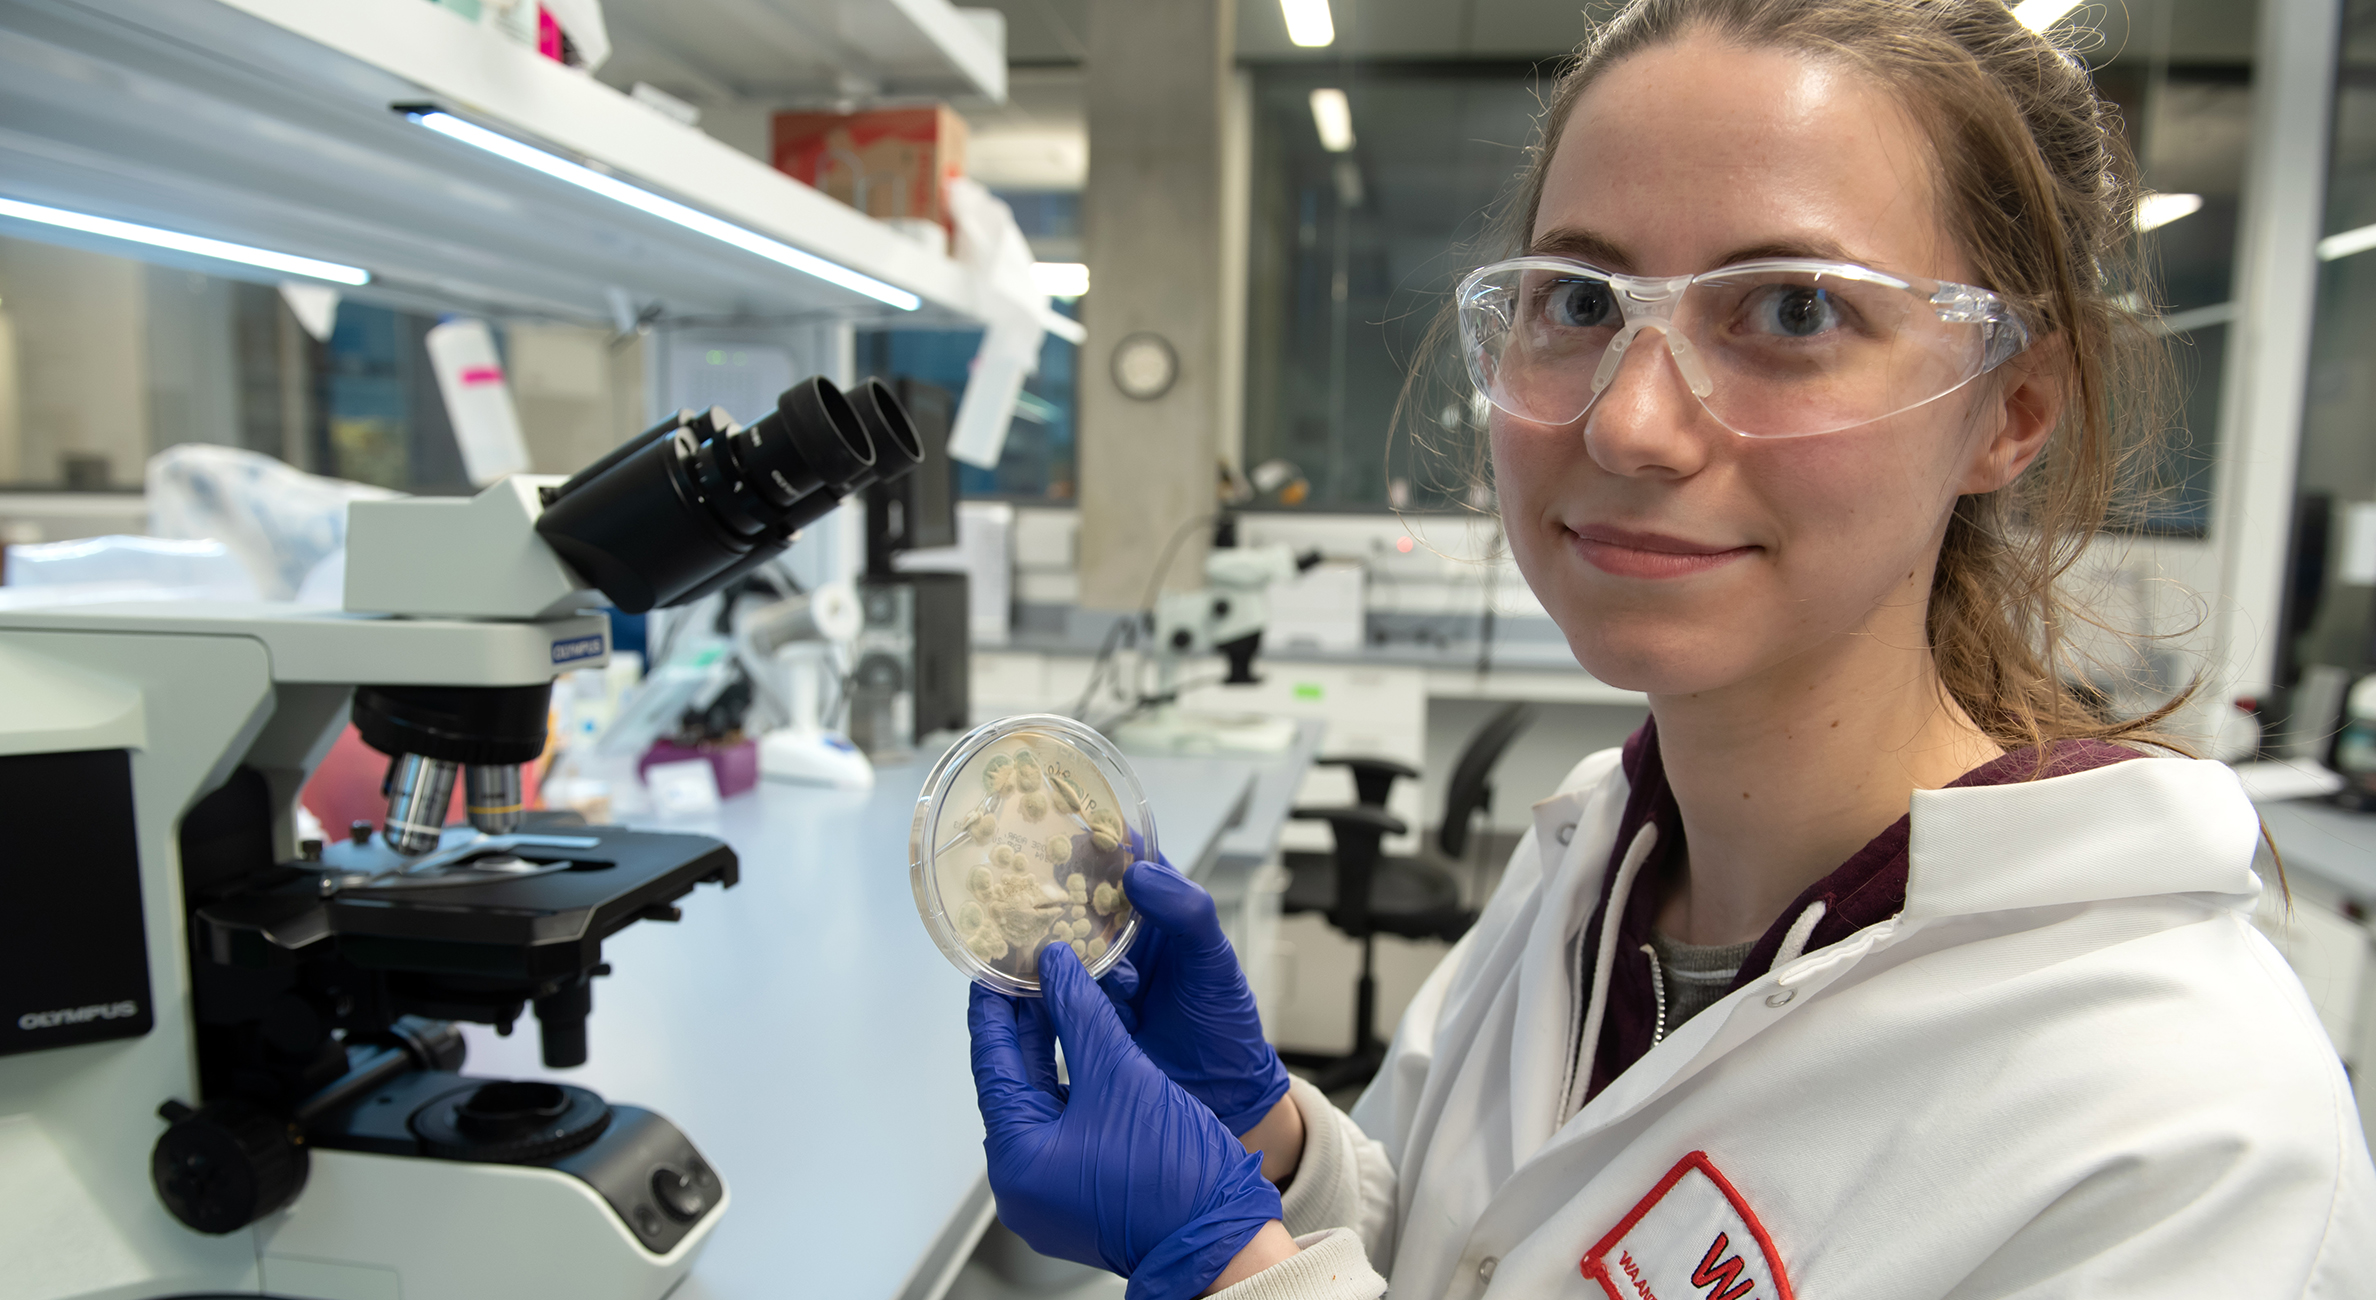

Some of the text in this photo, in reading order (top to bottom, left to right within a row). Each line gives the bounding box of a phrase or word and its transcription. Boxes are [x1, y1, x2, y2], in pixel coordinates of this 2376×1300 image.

[553, 639, 600, 660] OLYMPUS
[18, 1000, 138, 1031] OLYMPUS
[1691, 1231, 1761, 1300] W
